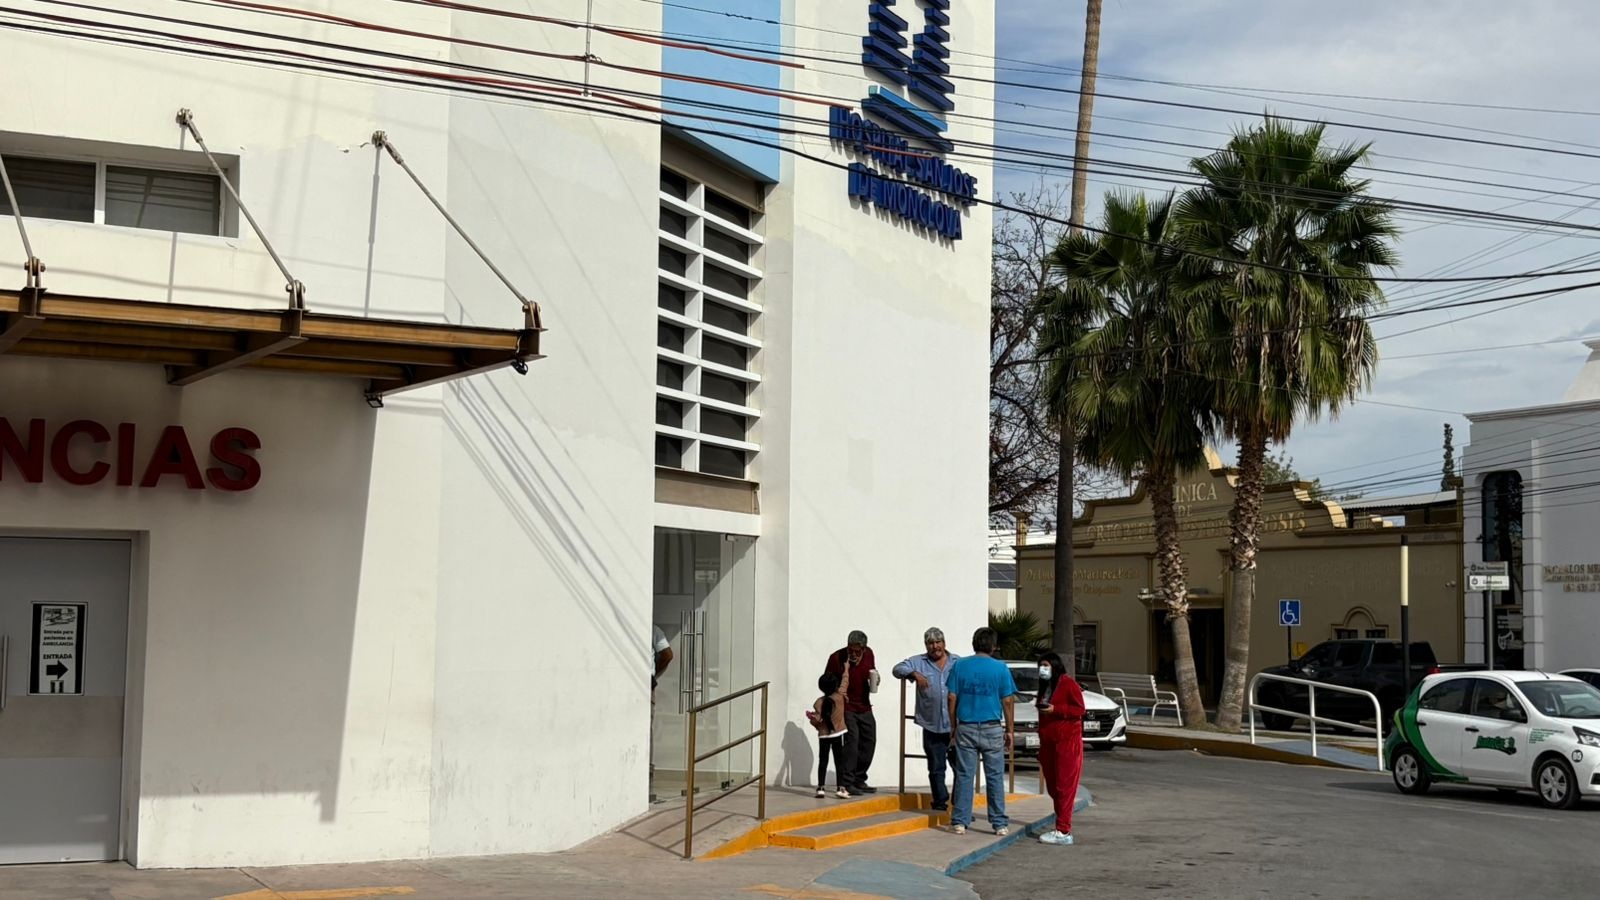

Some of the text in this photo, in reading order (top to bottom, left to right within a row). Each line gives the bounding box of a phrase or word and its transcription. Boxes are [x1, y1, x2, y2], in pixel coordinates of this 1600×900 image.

[829, 106, 912, 174] HOSPITAL
[848, 162, 962, 240] DE MONCLOVA
[1175, 482, 1218, 503] INICA
[1087, 521, 1156, 542] ORTOPEDI
